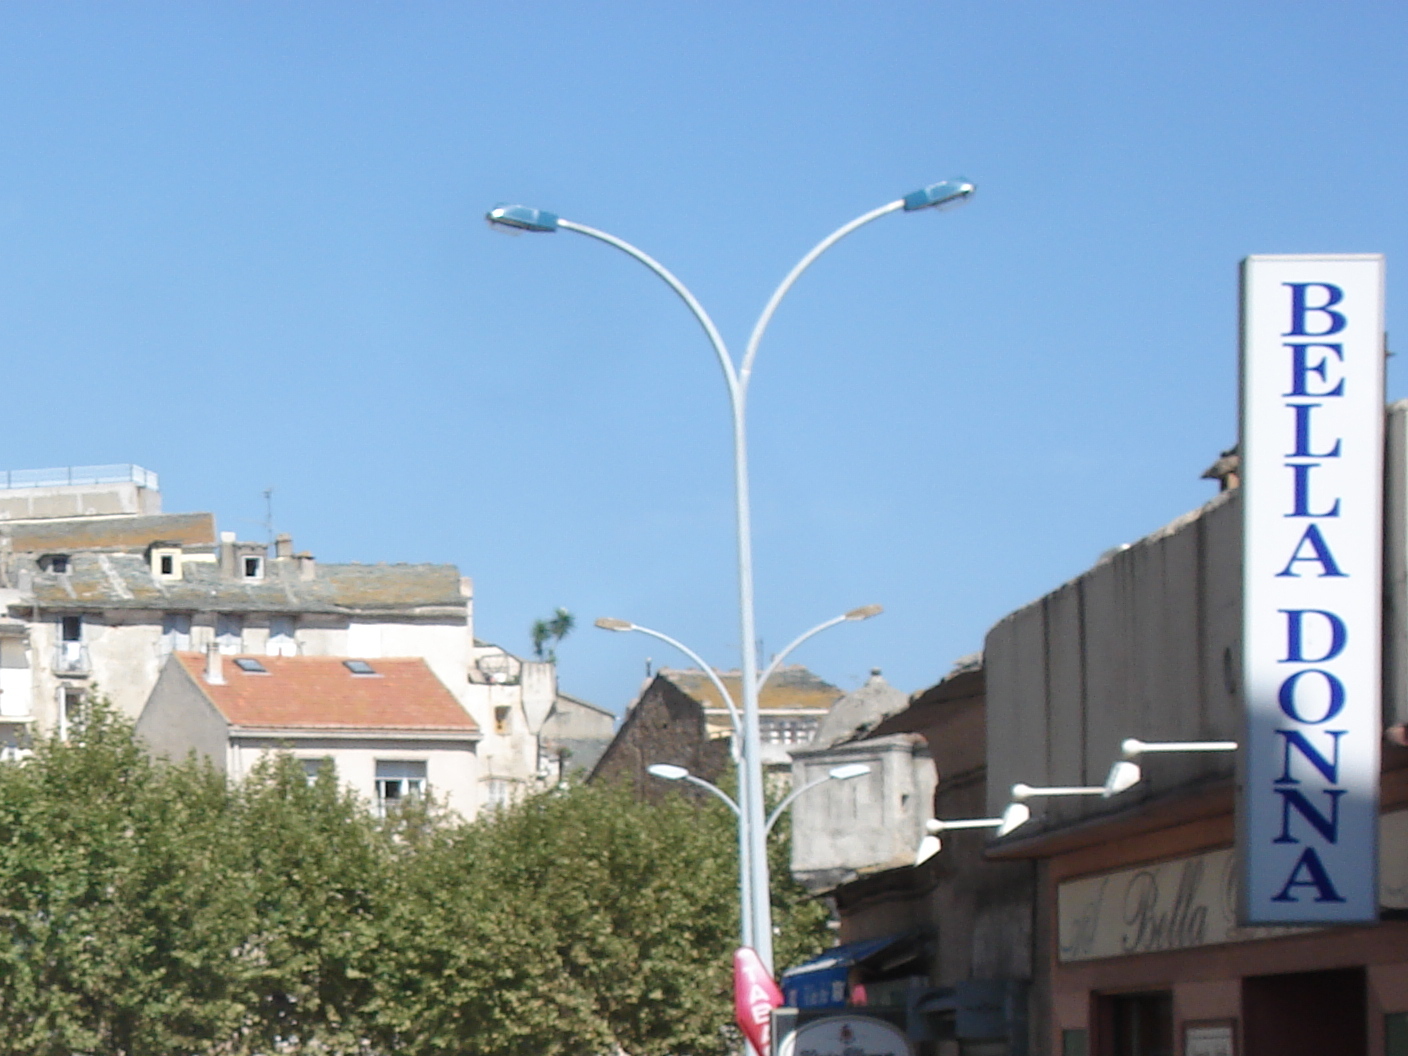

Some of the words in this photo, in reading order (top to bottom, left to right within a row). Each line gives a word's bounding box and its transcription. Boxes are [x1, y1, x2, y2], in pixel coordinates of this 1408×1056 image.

[1274, 281, 1351, 578] BELLA
[1270, 608, 1349, 903] DONNA
[1120, 857, 1210, 952] Bella
